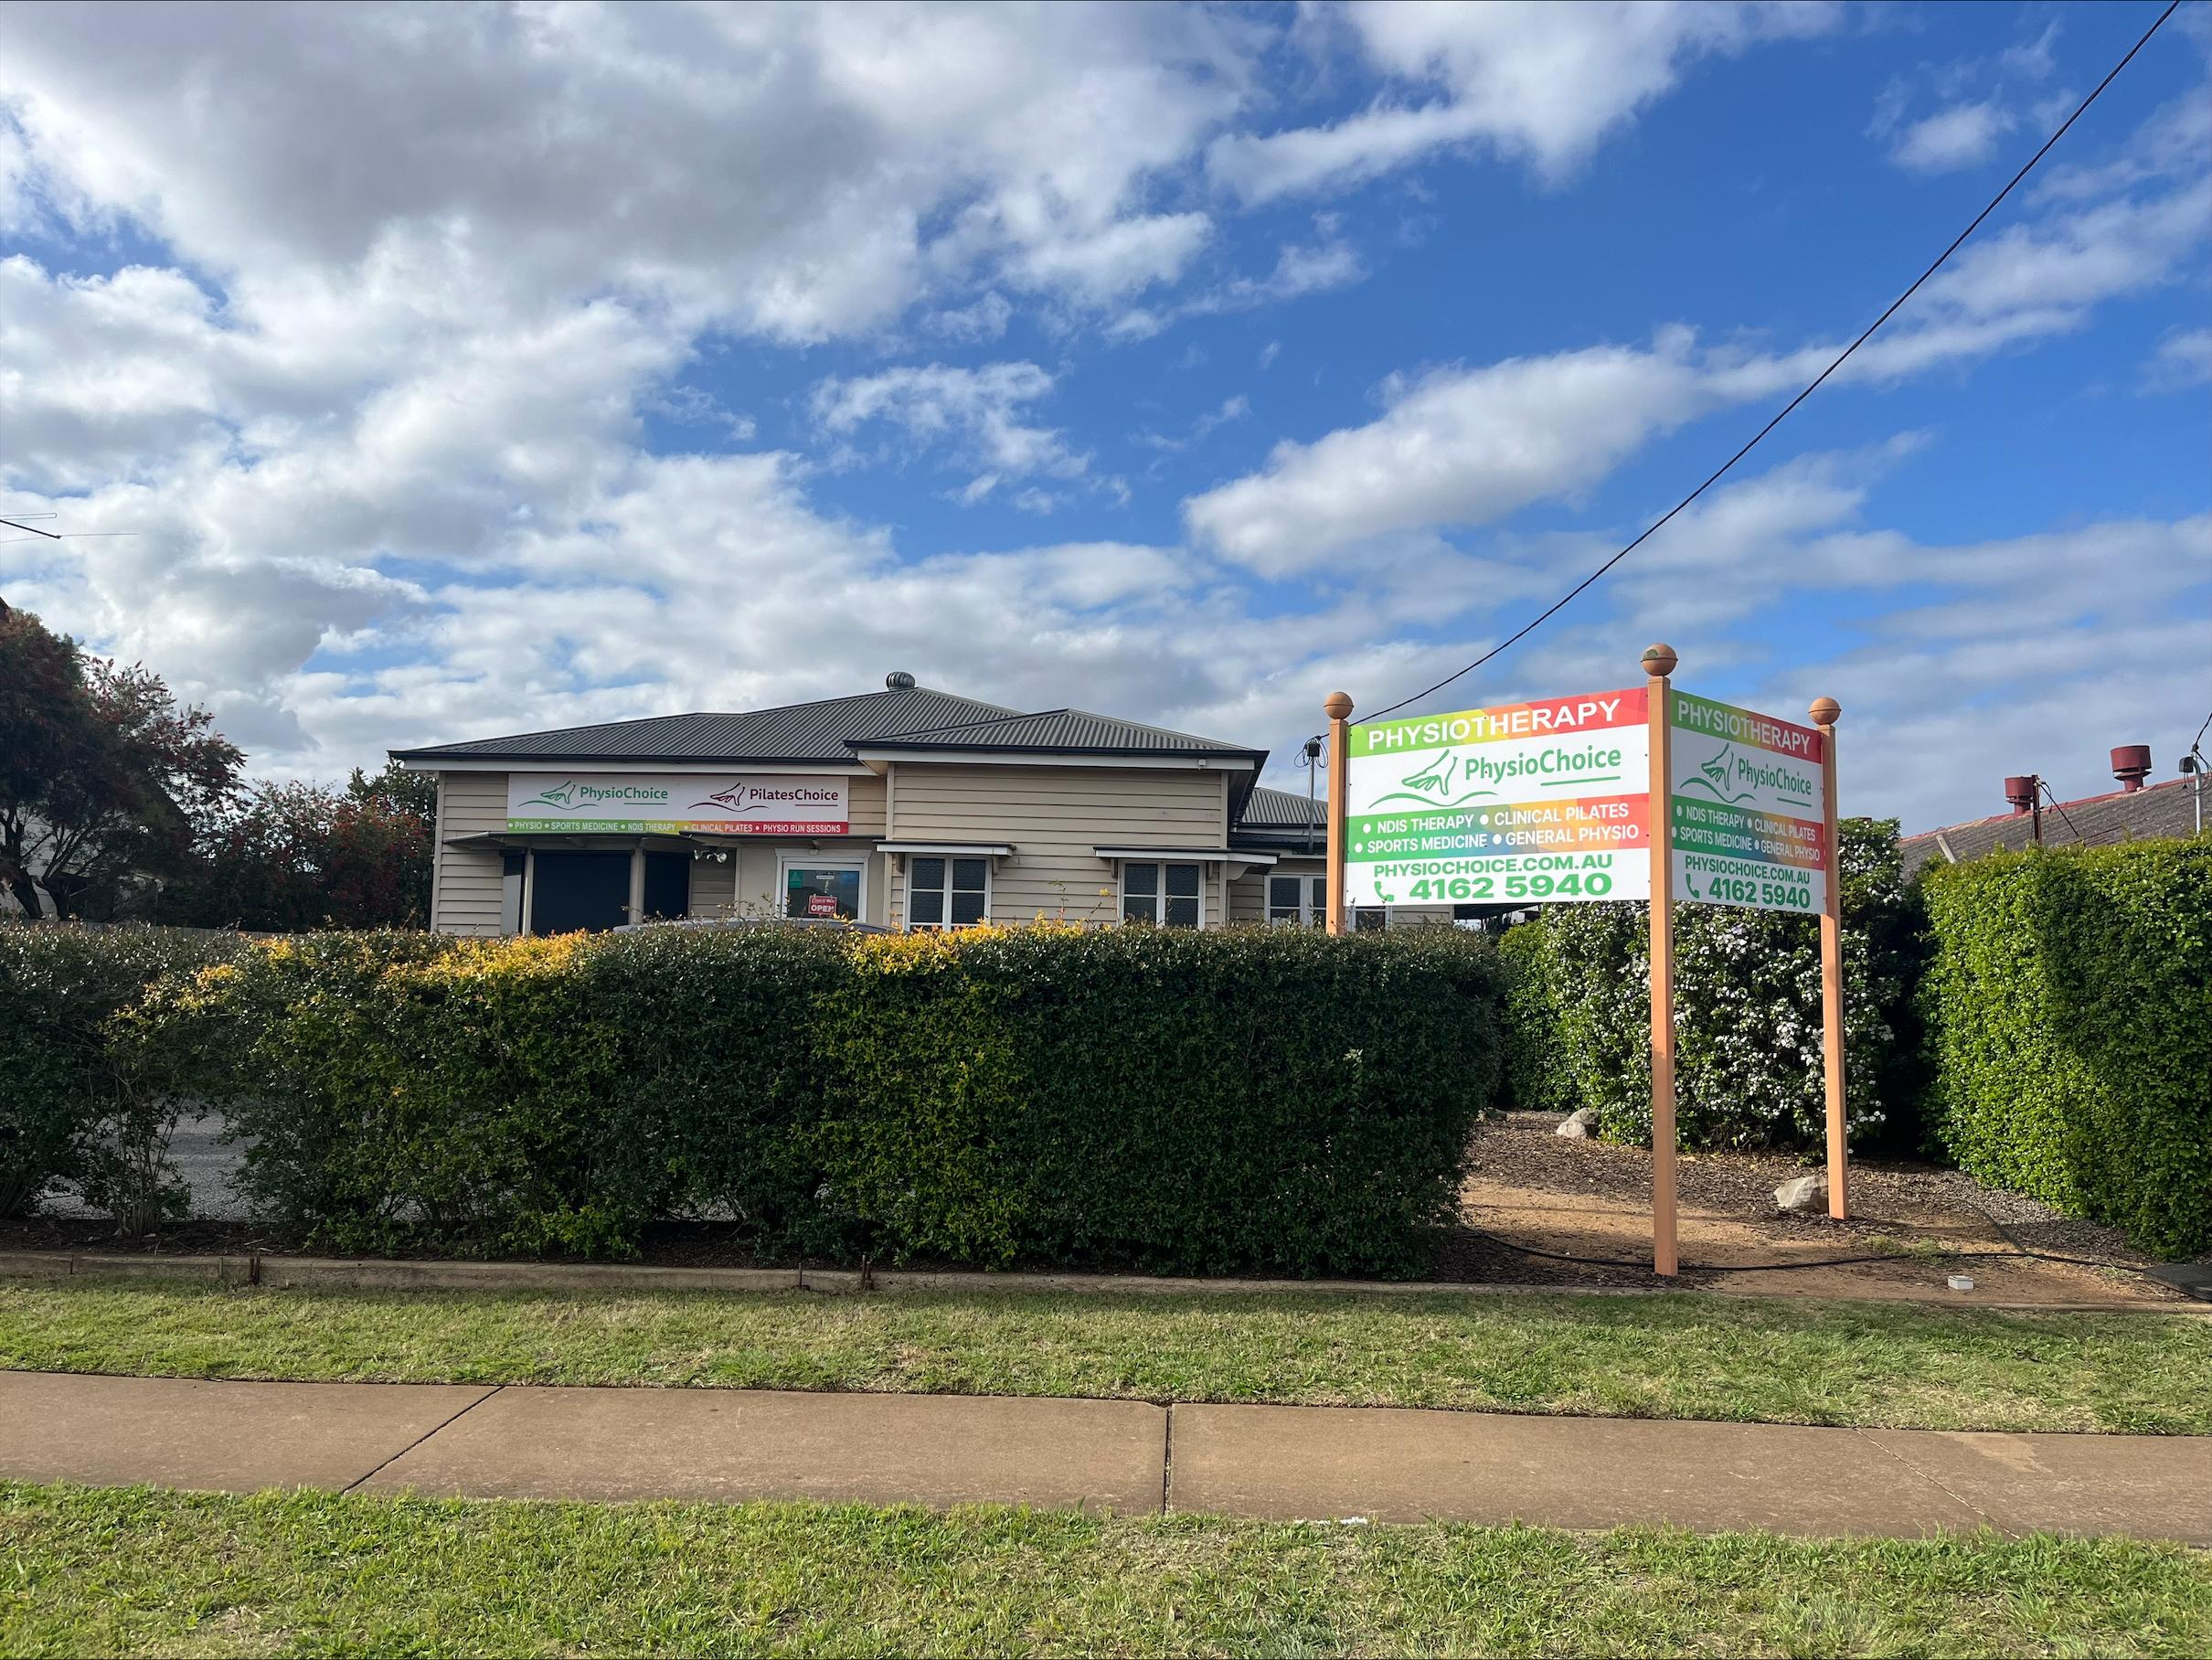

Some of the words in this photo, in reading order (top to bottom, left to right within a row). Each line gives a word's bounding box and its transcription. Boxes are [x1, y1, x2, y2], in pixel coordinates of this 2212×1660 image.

[1368, 698, 1621, 750] PHYSIOTHERAPY
[1677, 700, 1810, 754] PHYSIOTHERAPY
[1465, 745, 1621, 784] PhysioChoice
[1739, 758, 1812, 795] PhysioChoice
[580, 786, 668, 801] PhysioChoice
[750, 789, 838, 801] PilatesChoice
[515, 822, 542, 830] PHYSIO
[551, 822, 580, 831] SPORTS
[582, 823, 618, 831] MEDICINE
[627, 823, 643, 831] NDIS
[644, 823, 675, 832] THERAPY
[691, 824, 723, 832] CLINICAL
[725, 824, 753, 833] PILATES
[763, 825, 788, 833] PHYSIO
[790, 825, 805, 833] RUN
[806, 825, 841, 833] SESSIONS
[1377, 820, 1408, 835] NDIS
[1410, 814, 1473, 833] THERAPY
[1494, 808, 1561, 826] CLINICAL
[1566, 803, 1629, 821] PILATES
[1686, 805, 1707, 823] NDIS
[1707, 809, 1745, 829] THERAPY
[1754, 818, 1788, 837] CLINICAL
[1788, 825, 1815, 842] PILATES
[1367, 838, 1419, 855] SPORTS
[1421, 833, 1487, 851] MEDICINE
[1505, 828, 1575, 846] GENERAL
[1579, 825, 1639, 842] PHYSIO
[1680, 826, 1713, 845] SPORTS
[1715, 832, 1752, 851] MEDICINE
[1760, 840, 1793, 857] GENERAL
[1794, 846, 1820, 862] PHYSIO
[1374, 854, 1612, 878] PHYSIOCHOICE.COM.AU
[1685, 856, 1810, 885] PHYSIOCHOICE.COM.AU
[1409, 877, 1494, 900] 4162
[1505, 873, 1612, 898] 5940
[1708, 877, 1757, 903] 4162
[1762, 883, 1811, 909] 5940
[811, 904, 835, 912] OPEN
